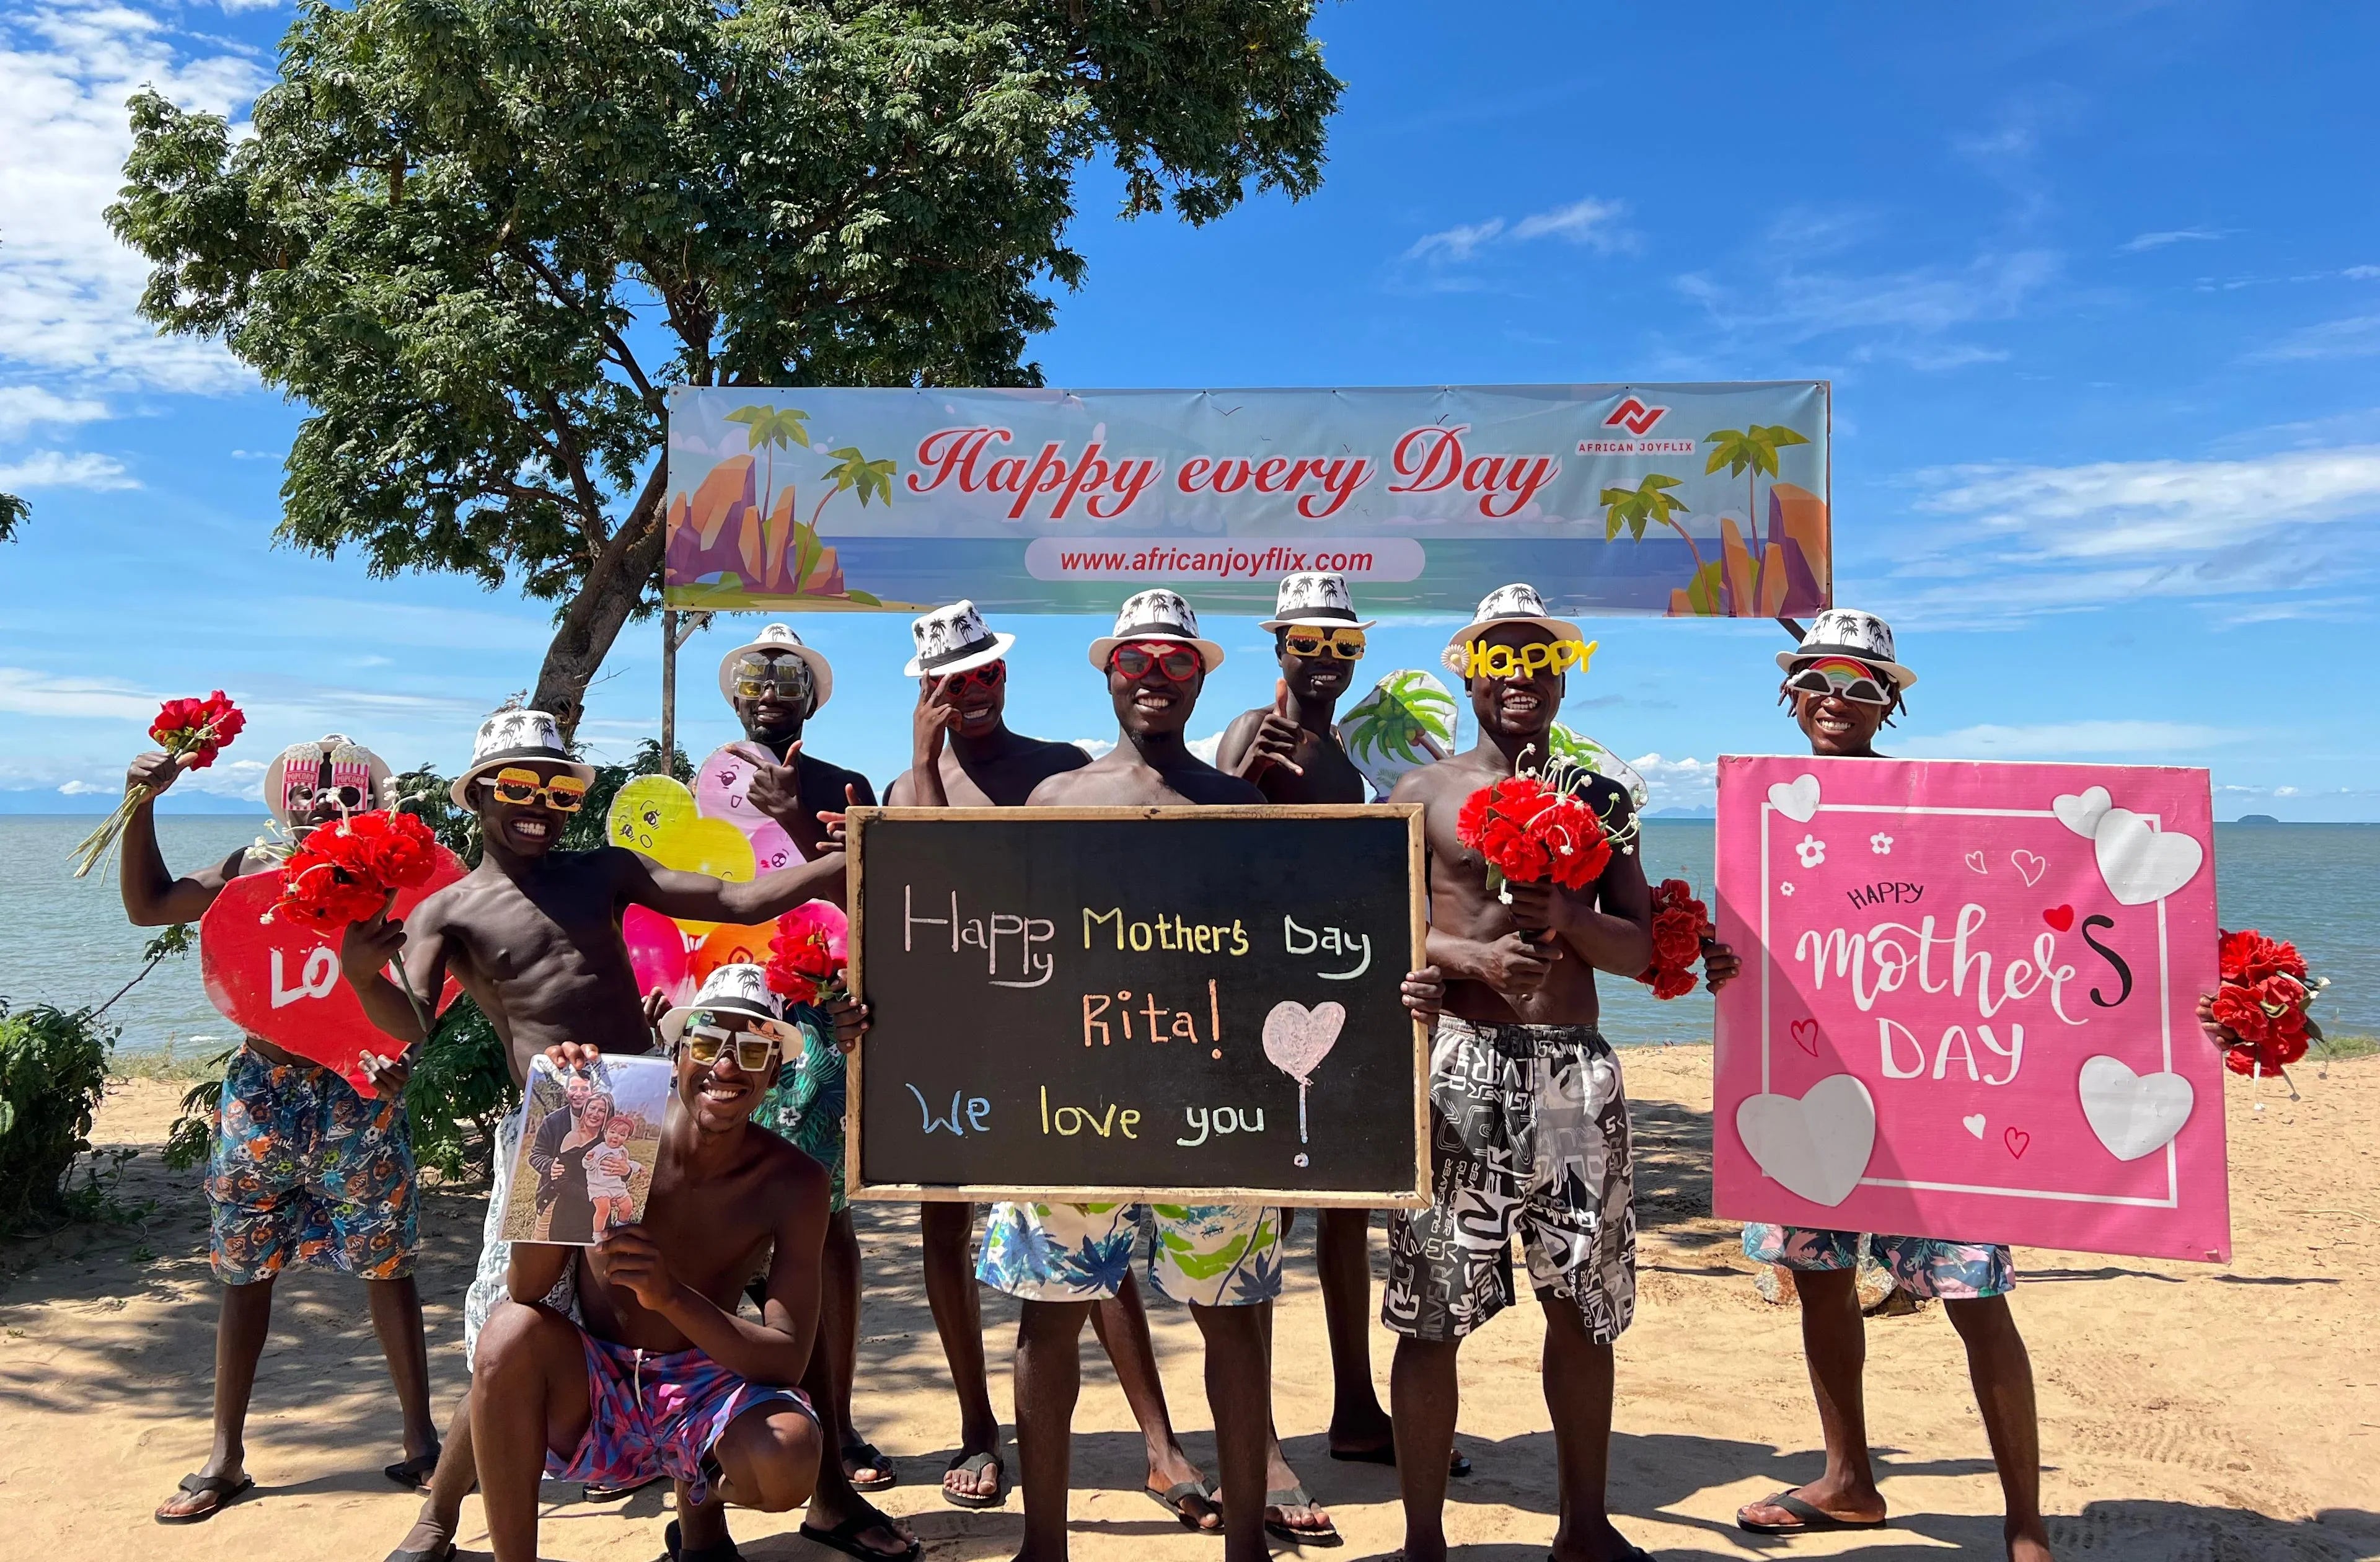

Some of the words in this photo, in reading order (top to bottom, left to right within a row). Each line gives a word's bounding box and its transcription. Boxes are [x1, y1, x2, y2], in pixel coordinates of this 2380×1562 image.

[1579, 443, 1633, 452] AFRICAN
[1639, 443, 1692, 451] JOYFLIX
[907, 428, 1162, 519] Happy
[1178, 457, 1375, 518] every
[1388, 426, 1559, 518] Day
[1060, 547, 1373, 577] www.africanjoyflix.com
[286, 772, 315, 782] POPCORN
[336, 775, 366, 786] POPCORN
[1846, 881, 1924, 909] HAPPY
[1284, 914, 1371, 980] Day
[1083, 978, 1223, 1060] Rita!
[1875, 1017, 2025, 1086] DAY
[905, 1082, 990, 1136] We
[1039, 1084, 1141, 1139] love
